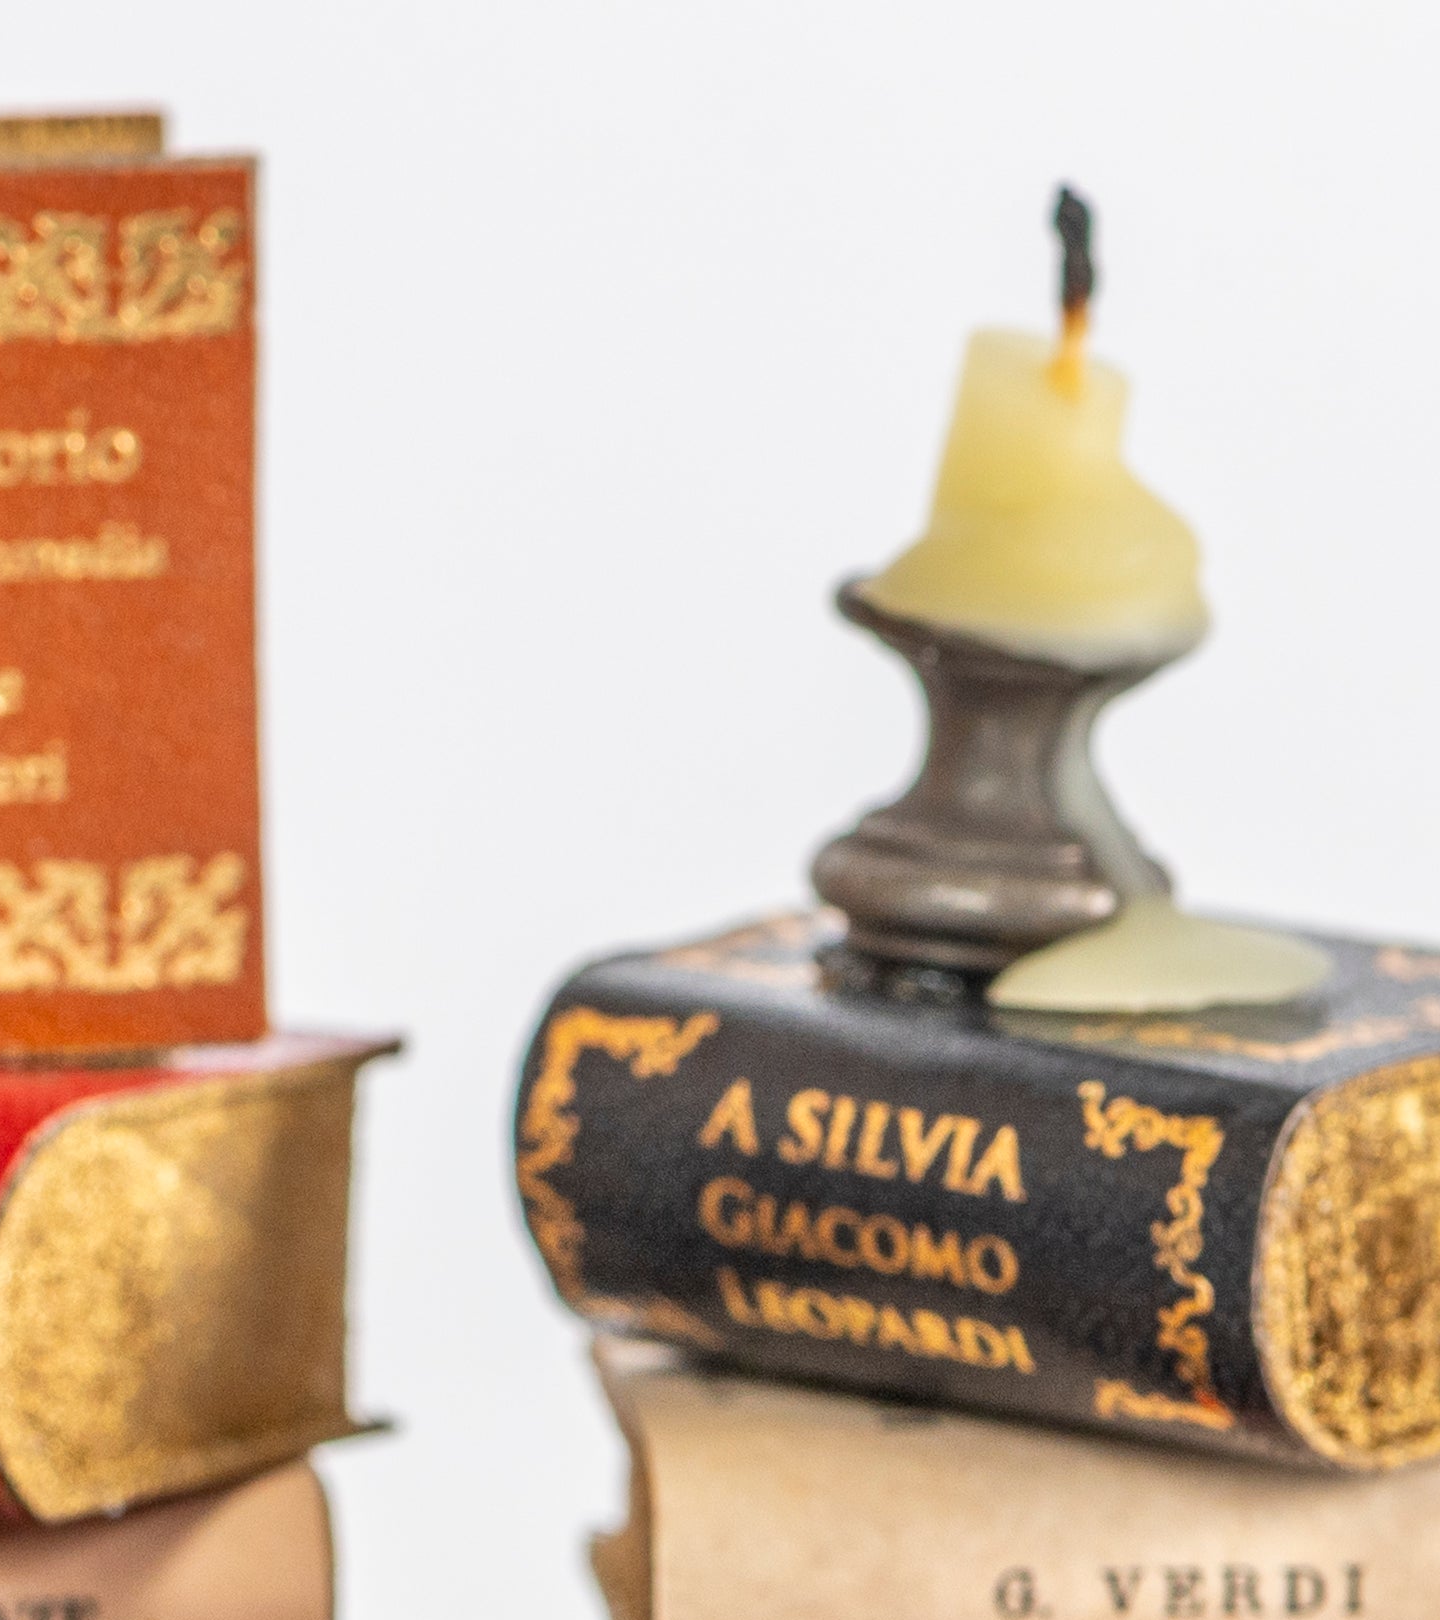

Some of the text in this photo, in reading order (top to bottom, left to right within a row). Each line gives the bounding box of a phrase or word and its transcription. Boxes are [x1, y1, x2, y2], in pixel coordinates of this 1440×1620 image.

[698, 1076, 1028, 1204] A SILVIA
[718, 1264, 1037, 1375] LEOPARDI
[1102, 1561, 1364, 1619] VERDI
